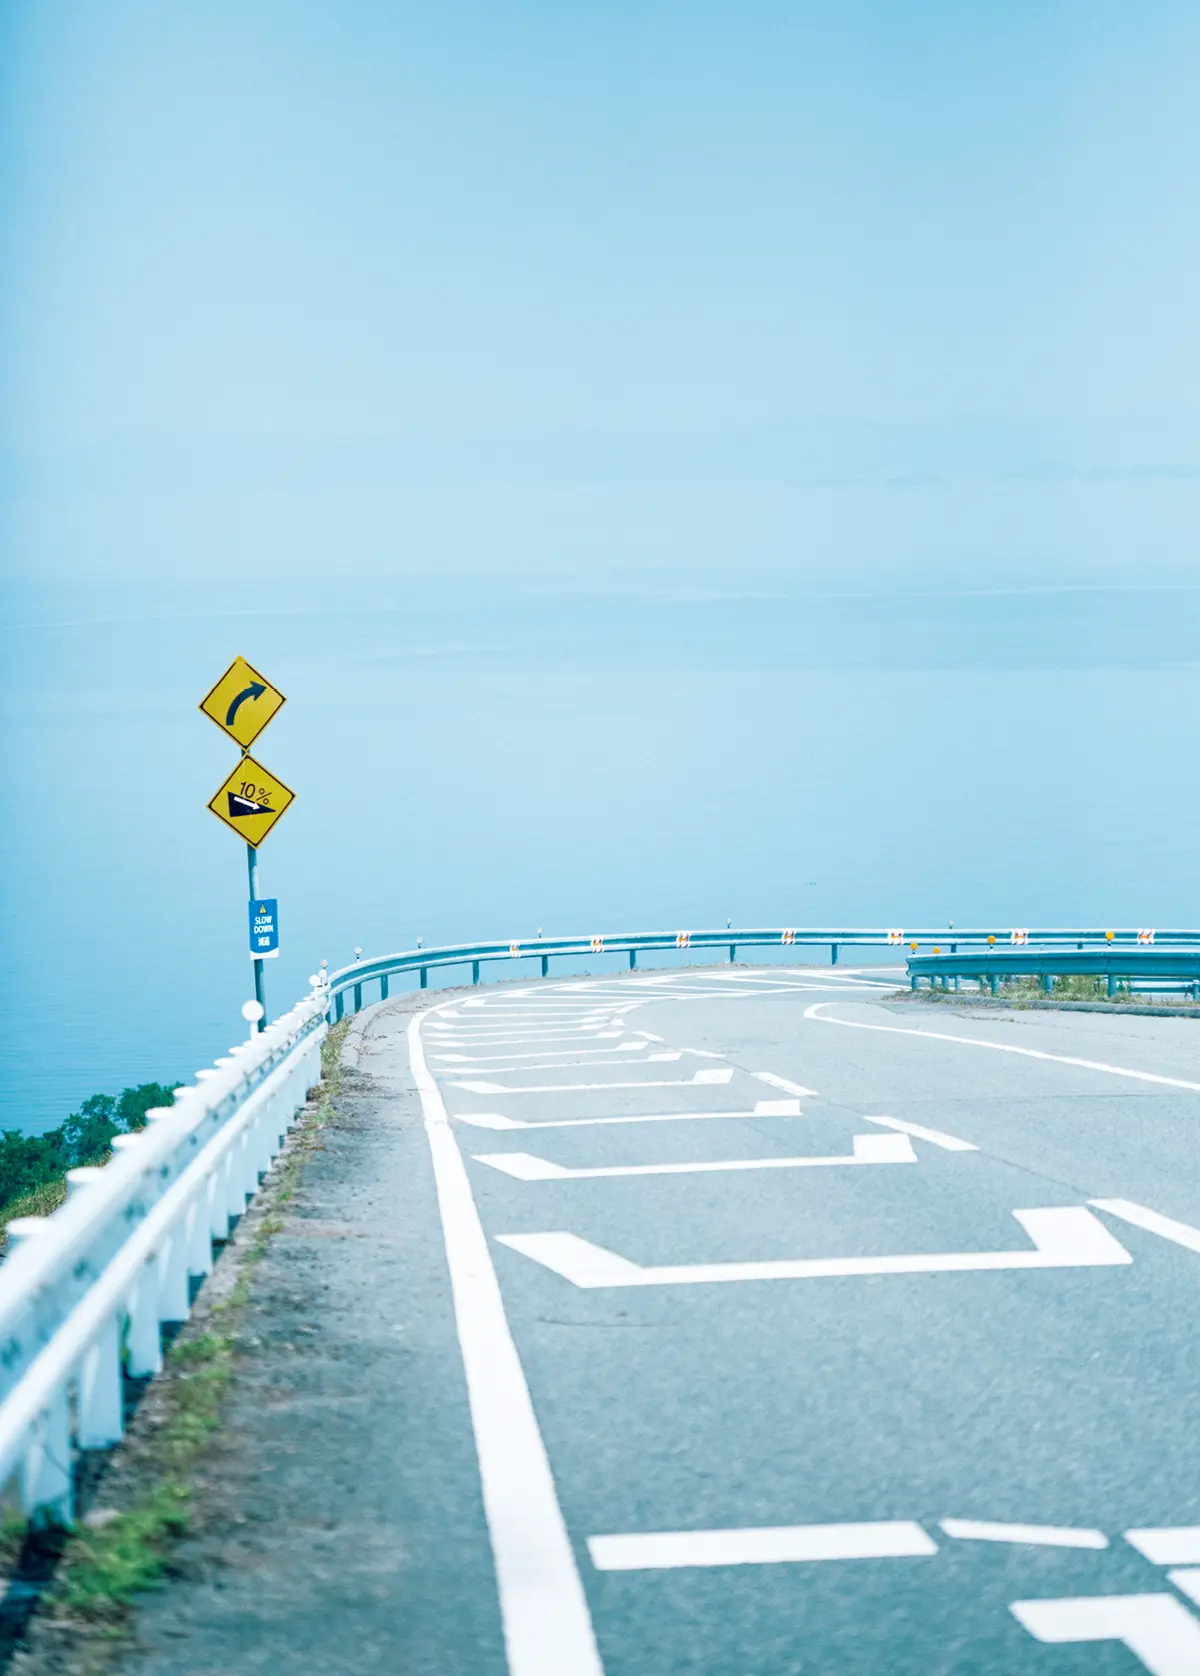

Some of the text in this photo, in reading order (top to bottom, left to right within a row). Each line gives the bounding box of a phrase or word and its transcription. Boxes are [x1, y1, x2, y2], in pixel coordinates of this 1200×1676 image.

[240, 781, 272, 805] 10%
[254, 915, 272, 925] SLOW
[253, 924, 274, 935] DOWN
